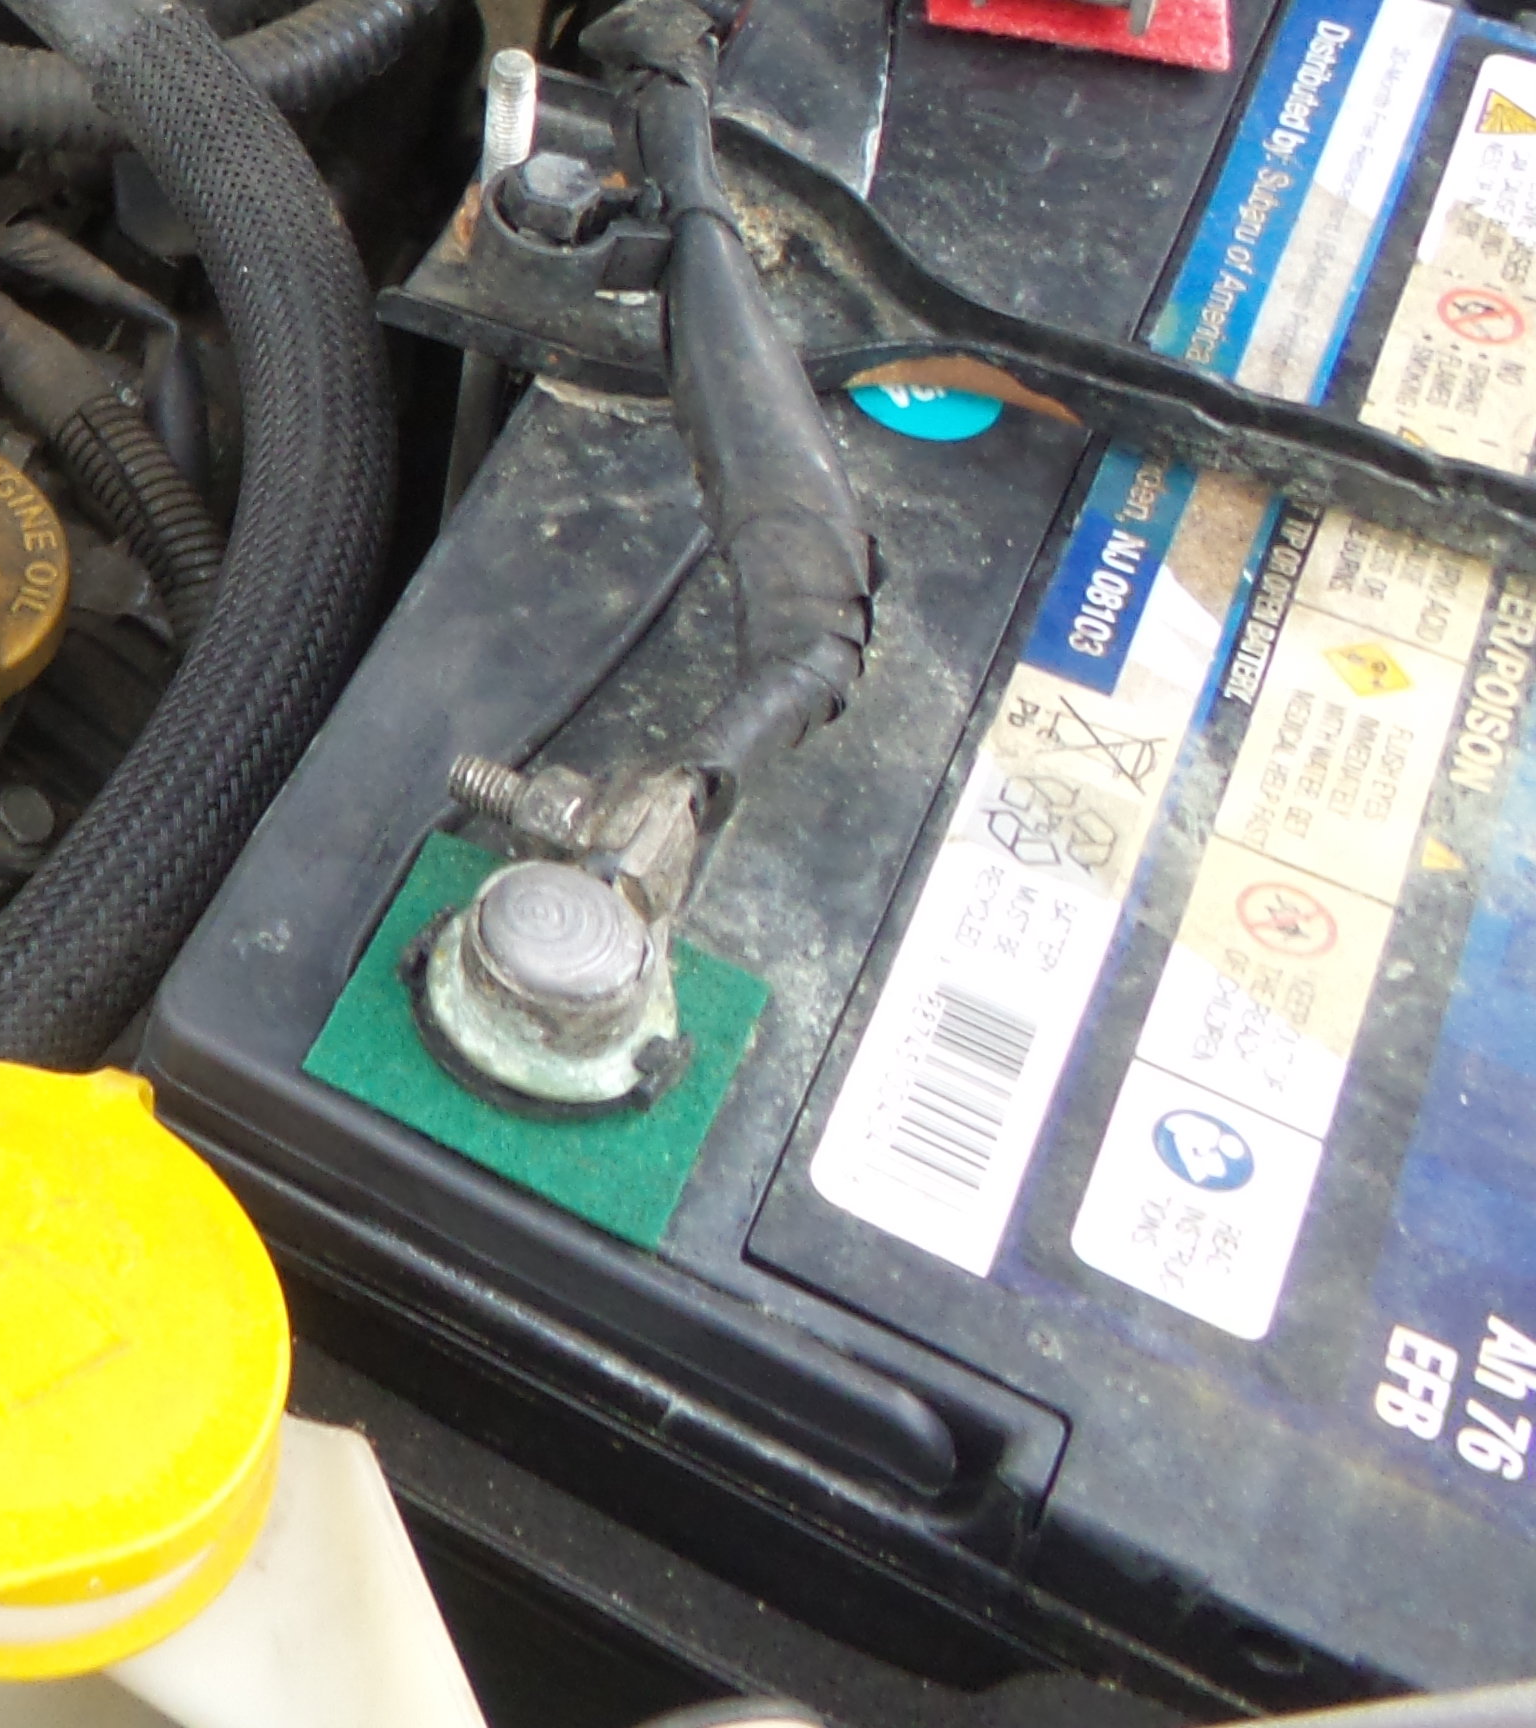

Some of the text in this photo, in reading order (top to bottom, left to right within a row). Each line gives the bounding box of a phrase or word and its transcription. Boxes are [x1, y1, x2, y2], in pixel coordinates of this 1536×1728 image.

[1275, 18, 1351, 135] Distributed
[1228, 165, 1291, 250] Subaru
[1221, 242, 1257, 274] of
[1183, 268, 1249, 367] America
[10, 560, 58, 615] OIL
[1097, 527, 1151, 576] NJ
[1265, 543, 1304, 577] OR
[1064, 566, 1134, 659] 08103
[1248, 570, 1294, 627] OPEN
[1269, 687, 1315, 761] MEDICAL
[1314, 700, 1348, 744] WITH
[1447, 582, 1535, 796] ER/POISON
[1255, 758, 1291, 805] HELP
[1324, 713, 1380, 822] IMMEDIATELY
[1360, 723, 1414, 825] FLUSH EYES
[1375, 1325, 1459, 1440] EFB
[1458, 1315, 1536, 1481] Ah 76
